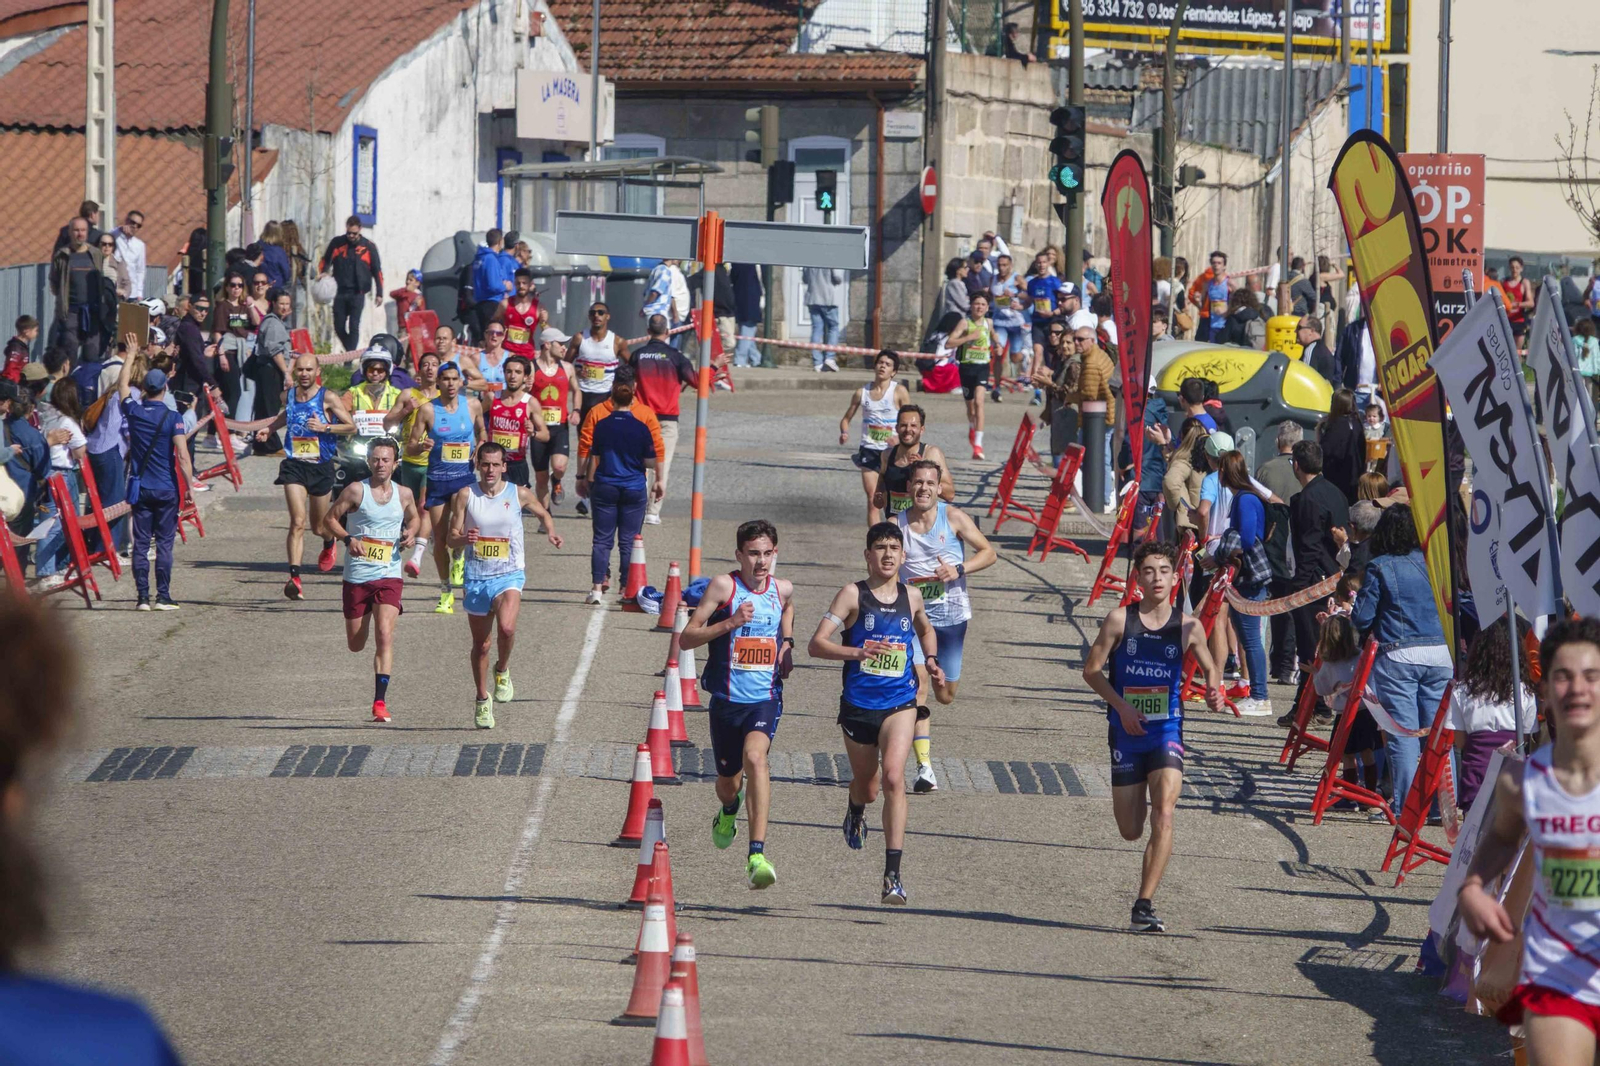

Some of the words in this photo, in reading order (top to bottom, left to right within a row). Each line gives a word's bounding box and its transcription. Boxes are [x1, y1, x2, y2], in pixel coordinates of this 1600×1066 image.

[1081, 0, 1096, 17] 86
[1097, 0, 1121, 17] 334
[1122, 2, 1145, 20] 732
[1157, 4, 1179, 21] Jos
[1241, 8, 1277, 29] López,
[541, 82, 551, 103] LA
[552, 77, 580, 107] MASERA
[1408, 162, 1472, 179] oporriño
[1411, 180, 1473, 225] OP.
[1428, 257, 1478, 267] ilómetros
[1434, 300, 1467, 315] Marz
[1486, 323, 1512, 391] cocinas
[354, 416, 384, 424] ORGANIZAC
[300, 443, 311, 453] 32
[451, 449, 462, 459] 65
[367, 546, 384, 561] 143
[483, 545, 500, 557] 108
[920, 584, 940, 600] 224
[738, 648, 772, 665] 2009
[869, 653, 899, 671] 2184
[1125, 664, 1171, 679] NARÓN
[1132, 698, 1161, 714] 2196
[1551, 867, 1600, 898] 222
